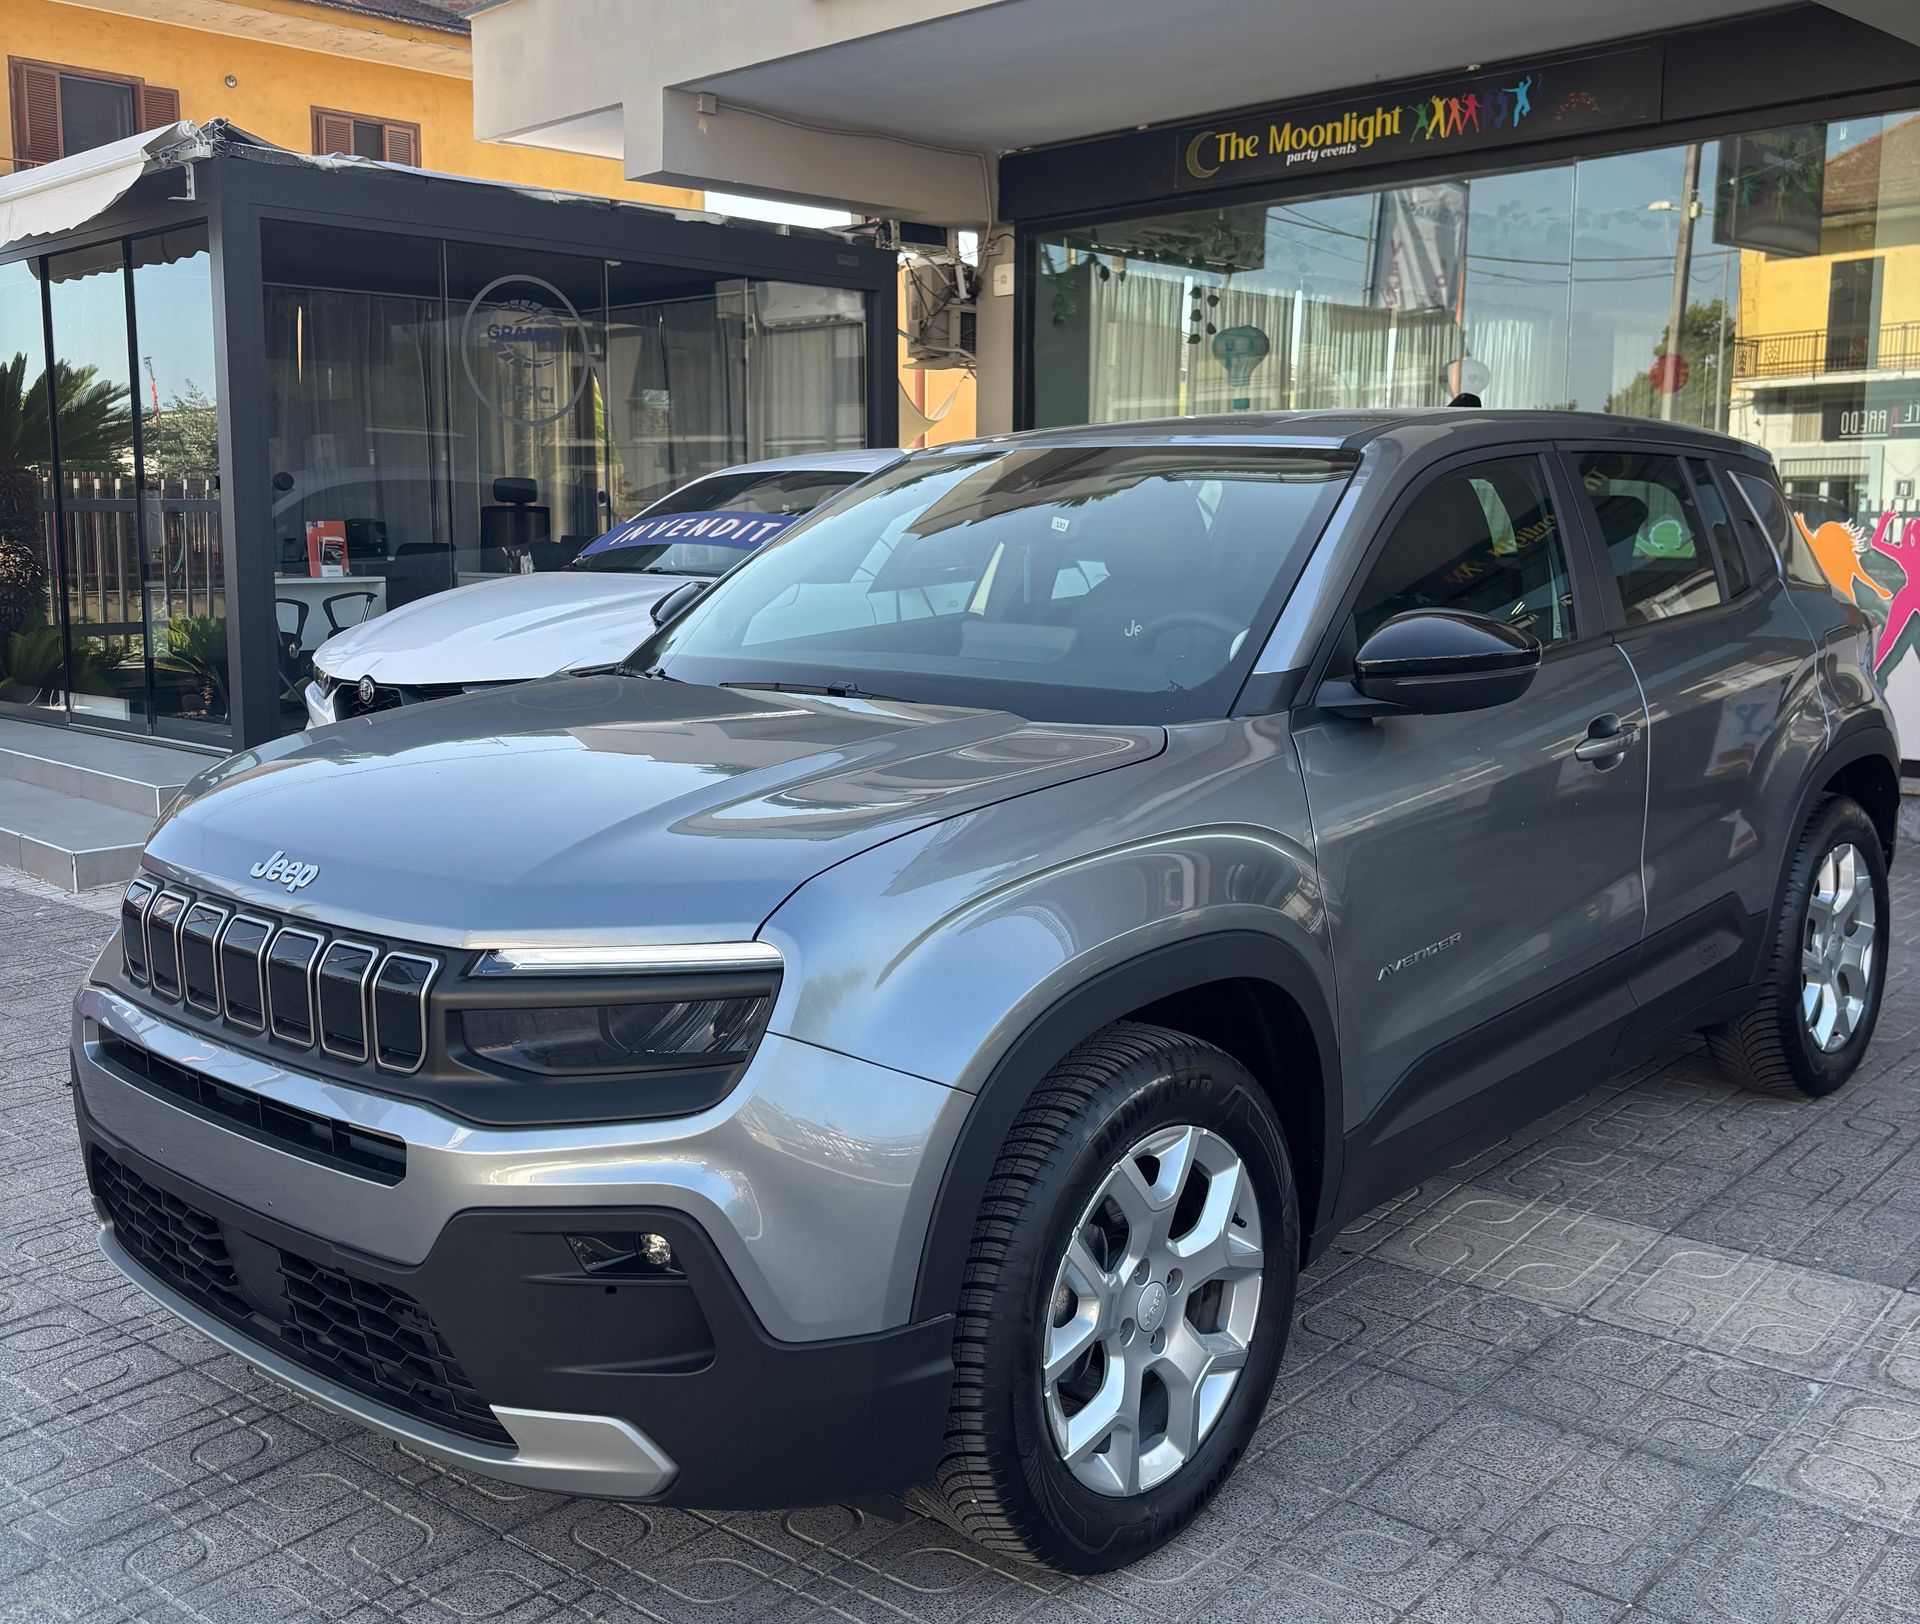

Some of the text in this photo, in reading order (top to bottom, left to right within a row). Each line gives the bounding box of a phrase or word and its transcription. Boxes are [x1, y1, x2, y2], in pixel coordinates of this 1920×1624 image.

[1215, 105, 1403, 163] The Moonlight
[1286, 143, 1357, 166] party events
[648, 517, 784, 545] VENDIT
[249, 850, 320, 893] Jeep
[1377, 931, 1462, 981] AVENGER
